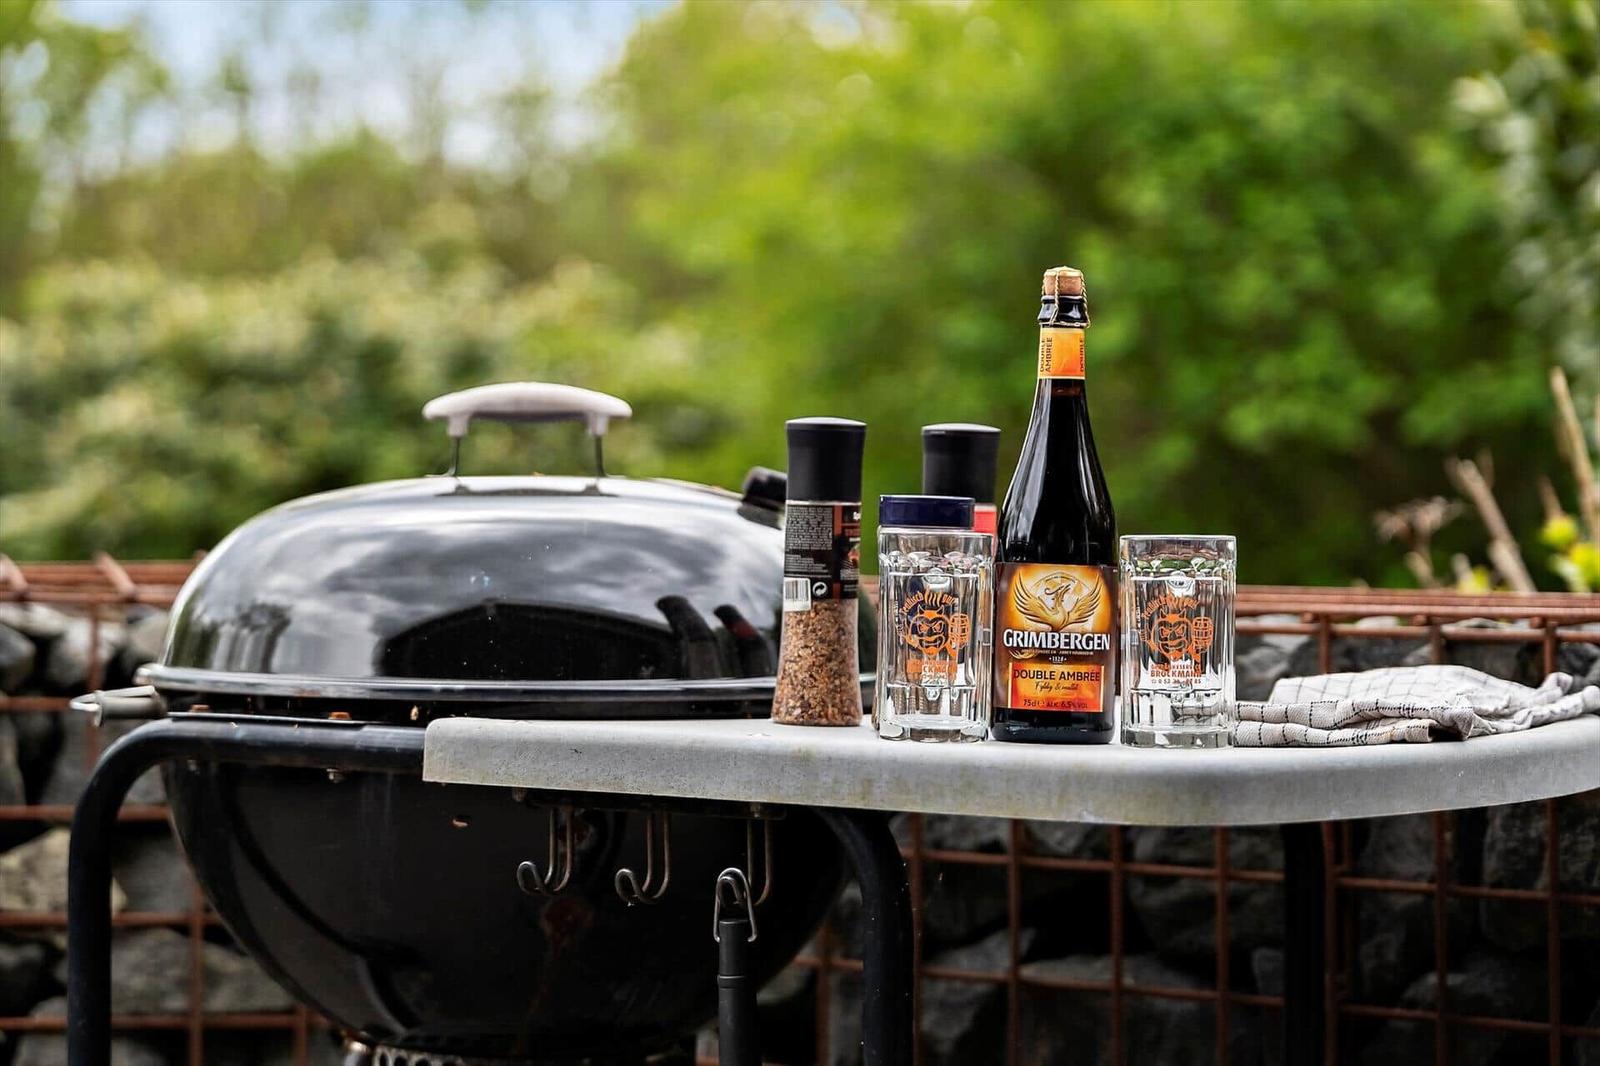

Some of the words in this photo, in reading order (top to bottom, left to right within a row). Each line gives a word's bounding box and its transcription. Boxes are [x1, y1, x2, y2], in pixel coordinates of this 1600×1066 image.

[1003, 628, 1111, 651] GRIMBERGEN
[1013, 669, 1056, 681] DOUBLE
[1058, 669, 1101, 682] AMBRÉE
